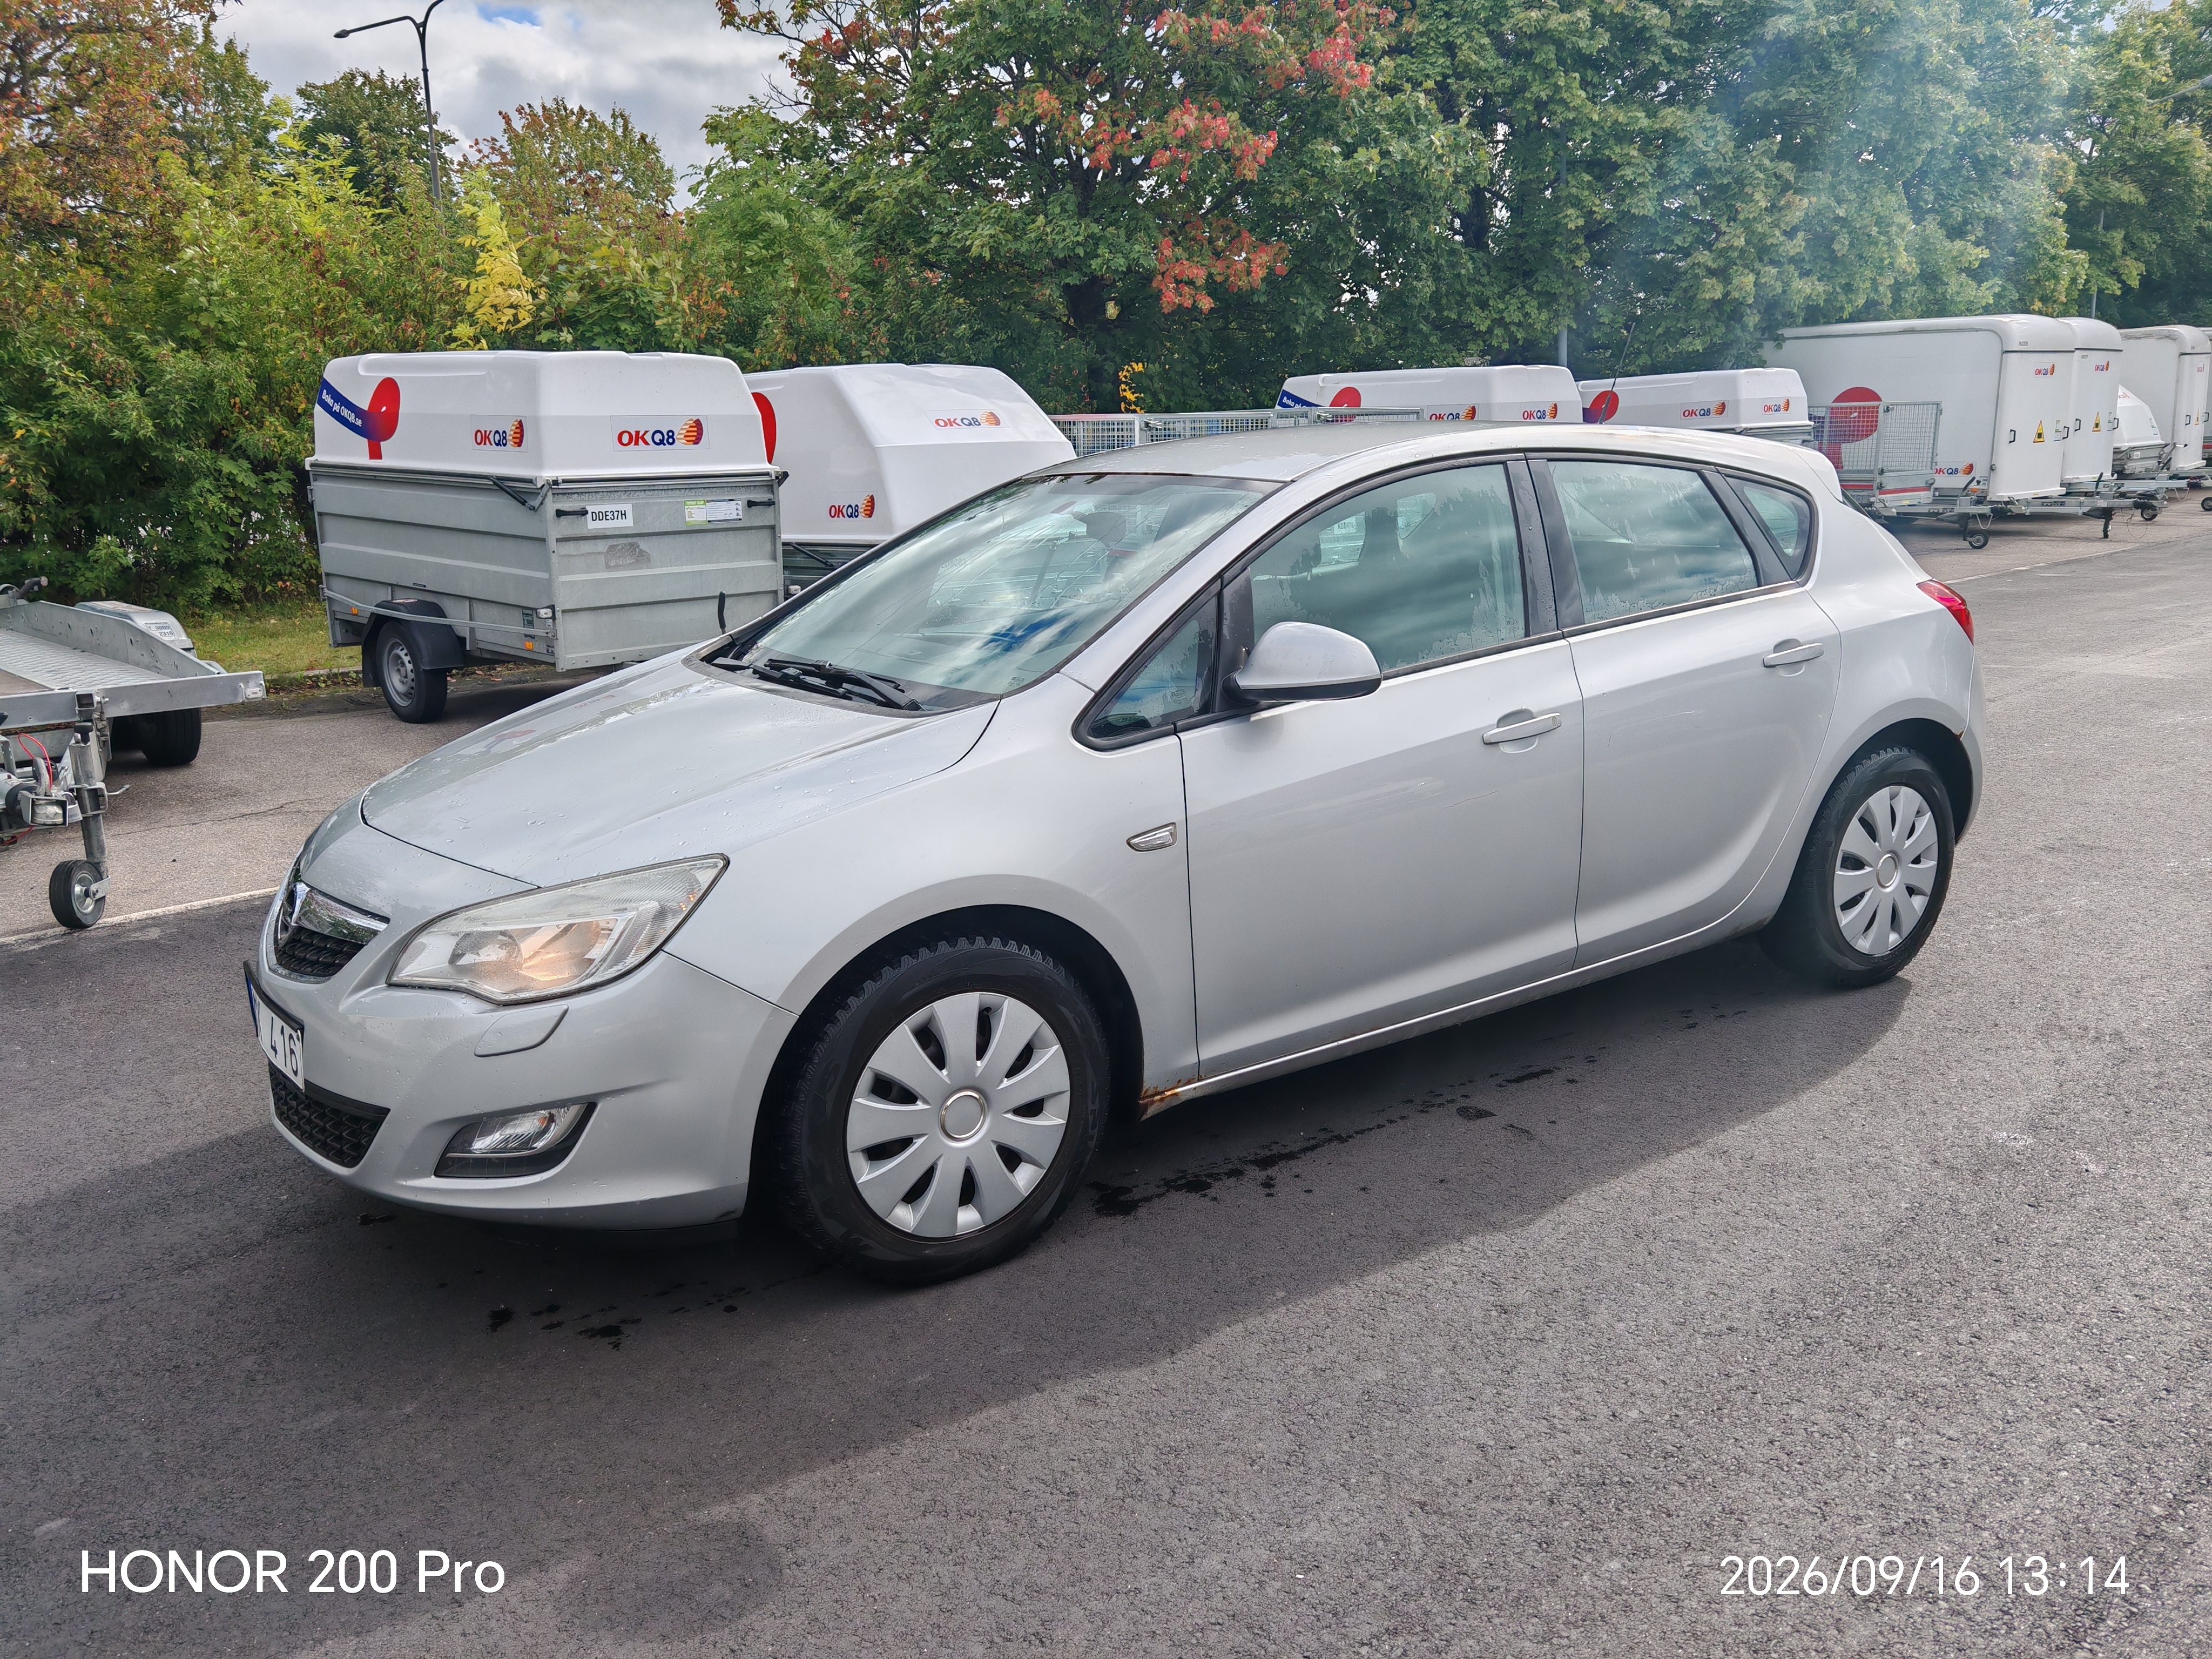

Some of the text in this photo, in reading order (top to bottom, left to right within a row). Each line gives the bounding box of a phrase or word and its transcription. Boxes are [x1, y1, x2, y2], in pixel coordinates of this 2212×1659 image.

[1282, 396, 1295, 407] Boka
[322, 389, 362, 427] Boka på OKQ8.se
[1682, 408, 1711, 418] OKQ8
[1763, 403, 1781, 414] OKQ8
[1522, 410, 1546, 420] OKQ8
[934, 417, 981, 427] OKQ8
[474, 429, 508, 447] OKQ8
[617, 429, 676, 447] OKQ8
[591, 510, 626, 522] DDE37H
[829, 504, 859, 519] OKQ8
[271, 1016, 299, 1077] 416
